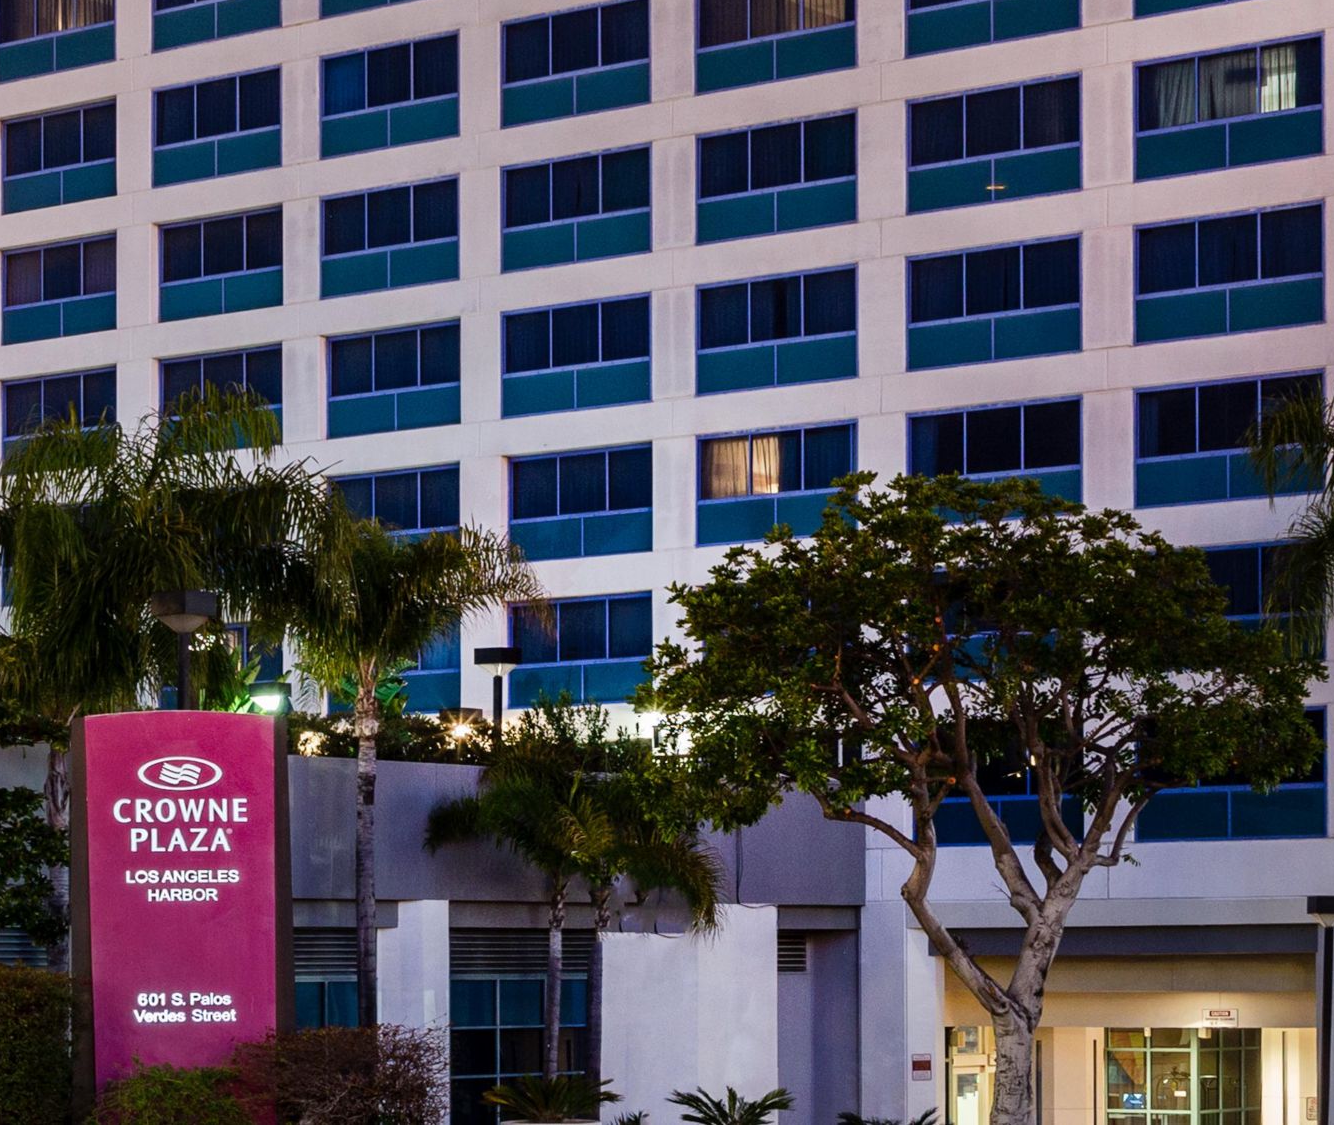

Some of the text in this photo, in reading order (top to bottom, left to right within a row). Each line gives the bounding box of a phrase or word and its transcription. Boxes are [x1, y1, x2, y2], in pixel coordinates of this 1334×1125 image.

[113, 797, 248, 823] CROWNE
[130, 827, 232, 852] PLAZA
[125, 869, 240, 884] LOS ANGELES
[147, 887, 219, 902] HARBOR
[137, 992, 233, 1007] 601 S. Palos
[133, 1008, 237, 1024] Verdes Street
